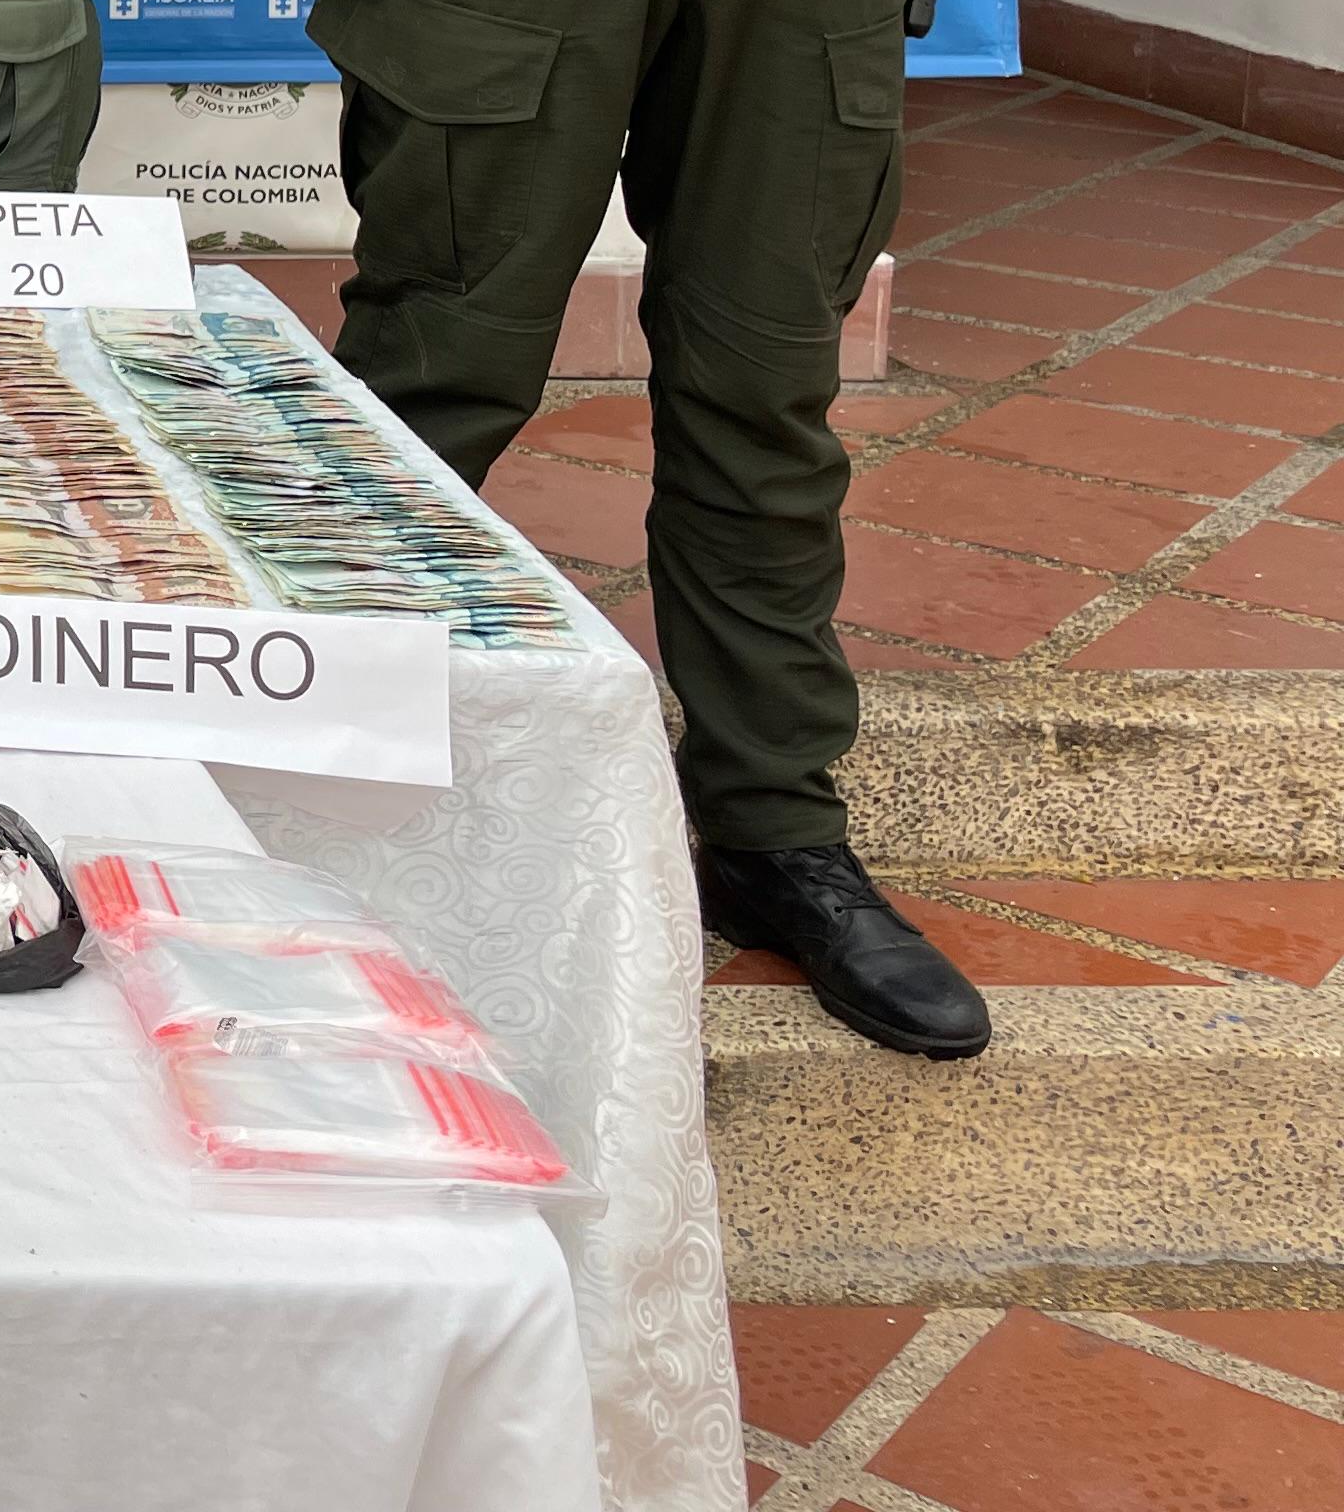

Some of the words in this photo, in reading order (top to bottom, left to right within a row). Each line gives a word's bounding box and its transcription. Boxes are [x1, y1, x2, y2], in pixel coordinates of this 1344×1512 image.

[237, 96, 281, 114] PATRIA
[136, 160, 227, 180] POLICÍA
[235, 163, 343, 181] NACIONA
[202, 188, 321, 204] COLOMBIA
[9, 262, 65, 297] 20
